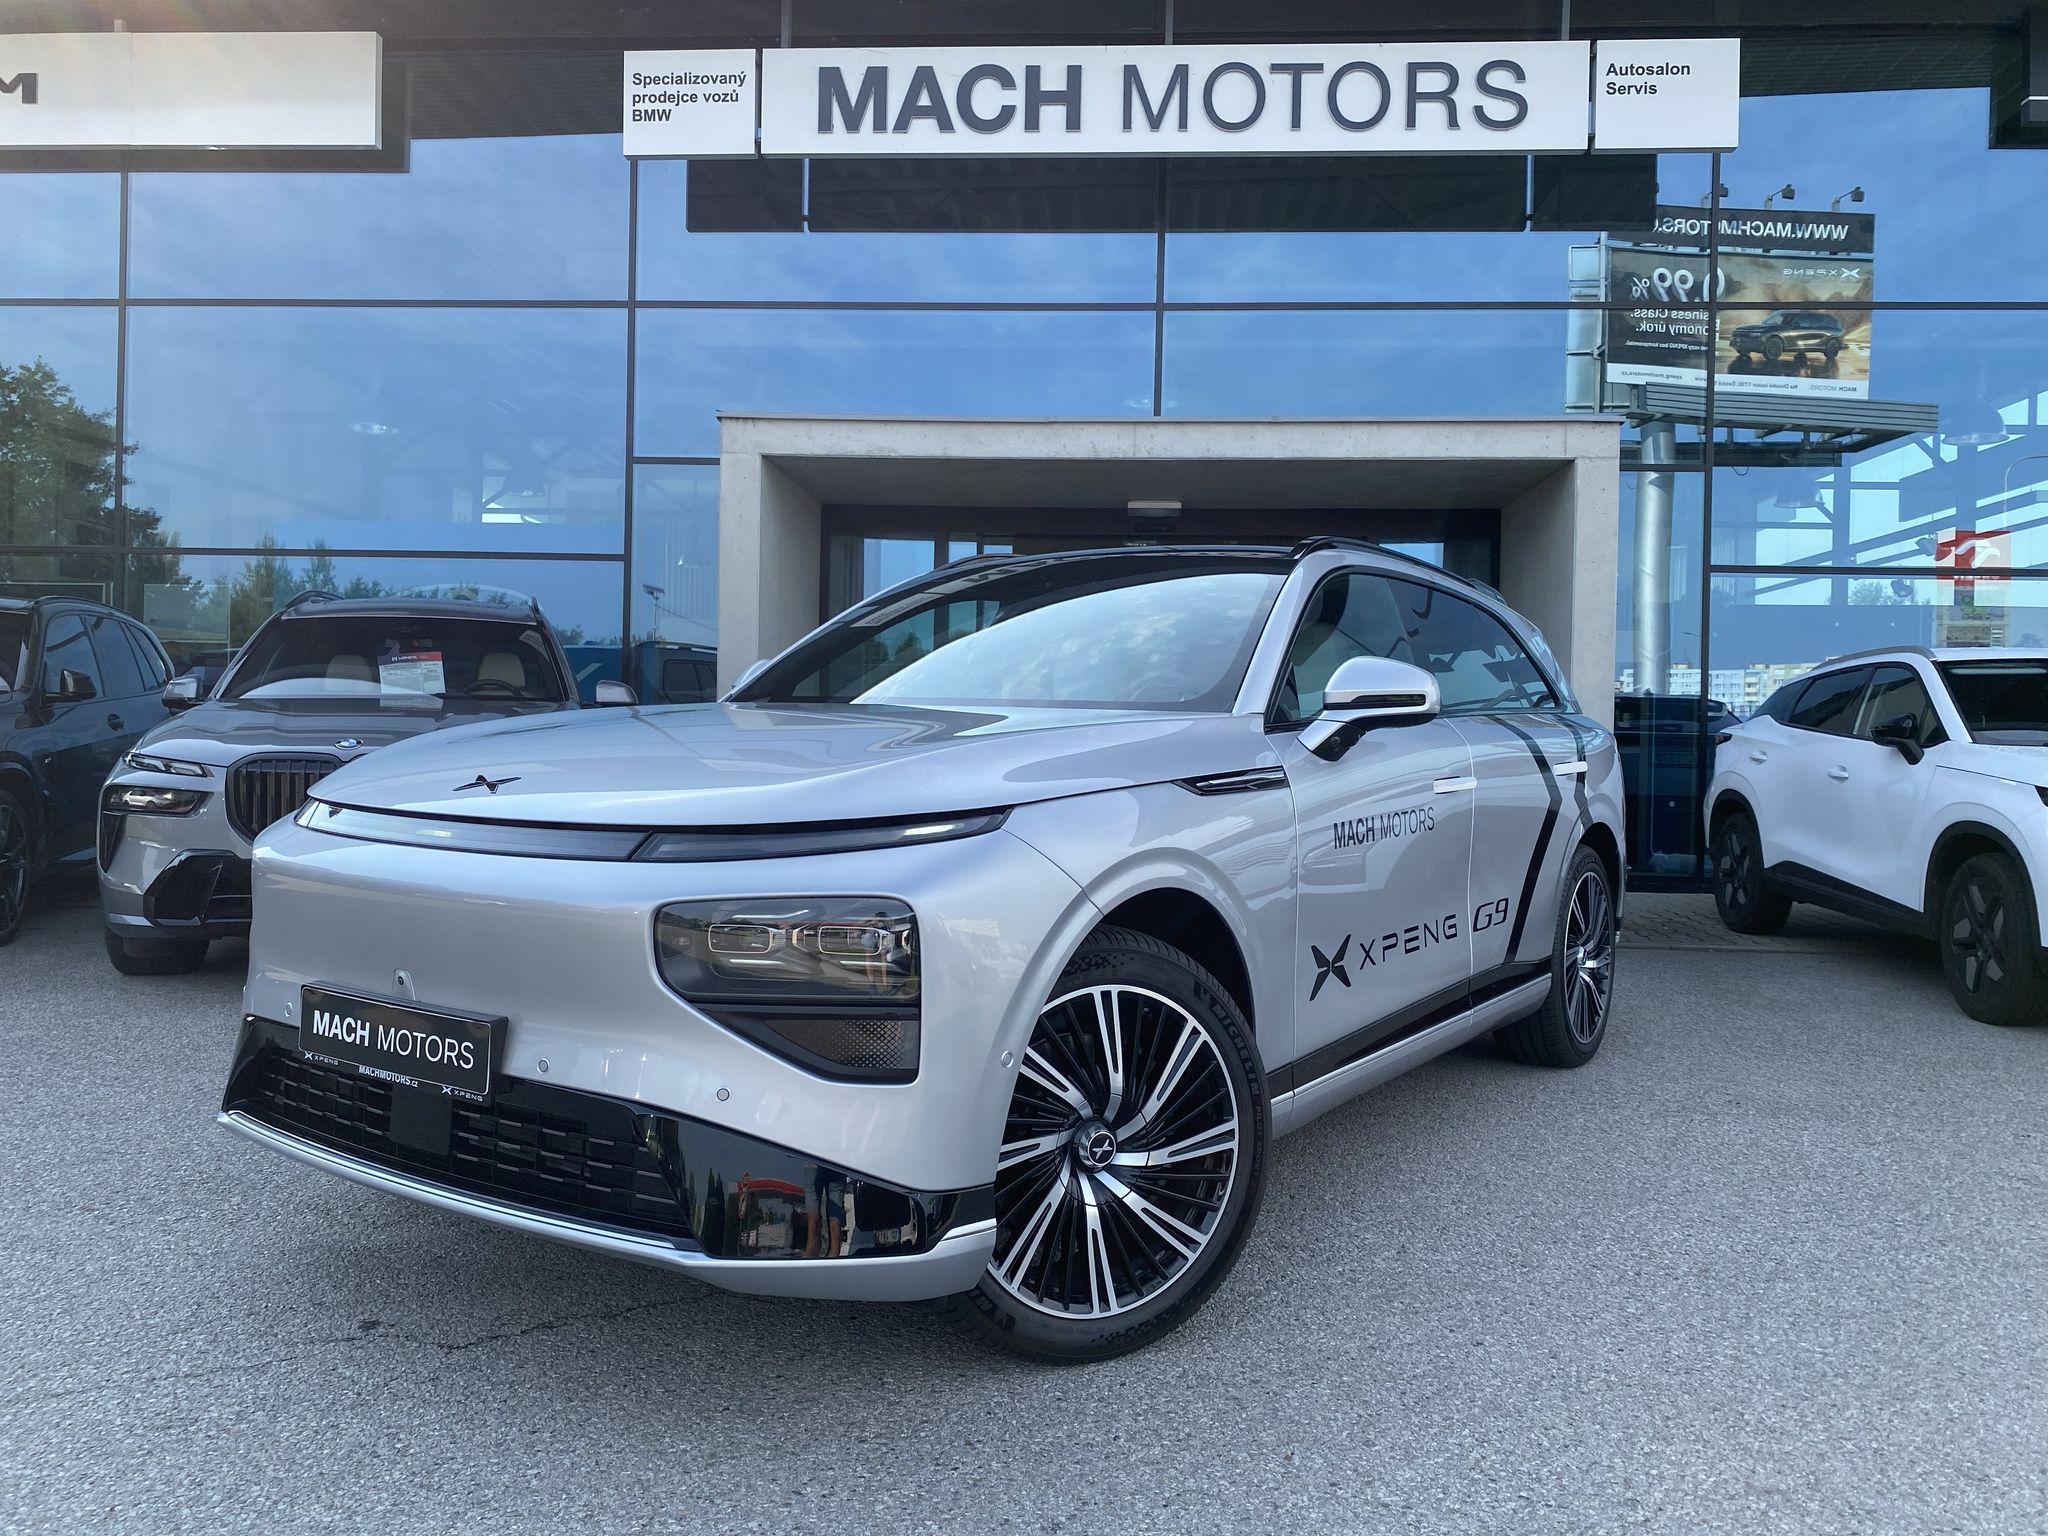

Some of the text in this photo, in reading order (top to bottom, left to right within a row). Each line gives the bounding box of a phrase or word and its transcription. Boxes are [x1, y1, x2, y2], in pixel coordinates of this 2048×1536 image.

[1605, 60, 1692, 78] Autosalon
[632, 70, 747, 88] Specializovaný
[1605, 80, 1658, 96] Servis
[632, 88, 740, 107] prodejce vozů
[818, 59, 1529, 134] MACH MOTORS
[632, 109, 672, 123] BMW
[1333, 806, 1435, 850] MACH MOTORS
[1359, 897, 1509, 971] XPENG G9
[312, 1009, 474, 1070] MACH MOTORS
[1211, 1003, 1261, 1096] MICHELIN
[314, 1054, 339, 1066] XPENG
[453, 1089, 483, 1102] XPENG
